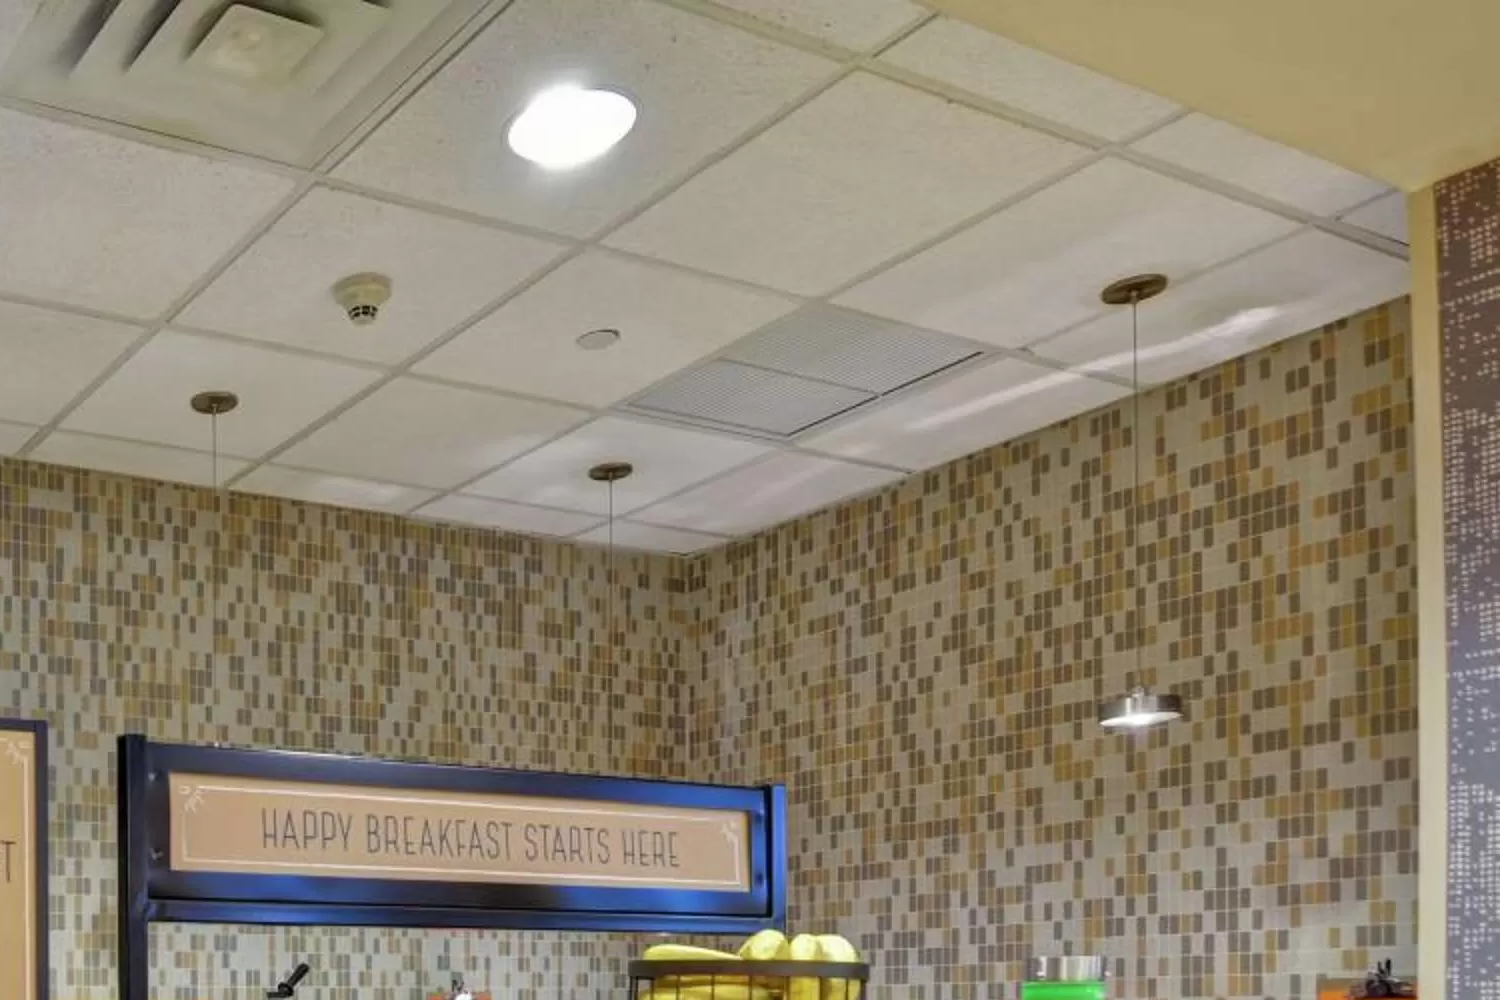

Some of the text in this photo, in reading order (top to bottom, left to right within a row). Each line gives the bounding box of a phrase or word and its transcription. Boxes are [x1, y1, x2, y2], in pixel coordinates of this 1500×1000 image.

[261, 808, 681, 869] HAPPY BREAKFAST STARTS HERE
